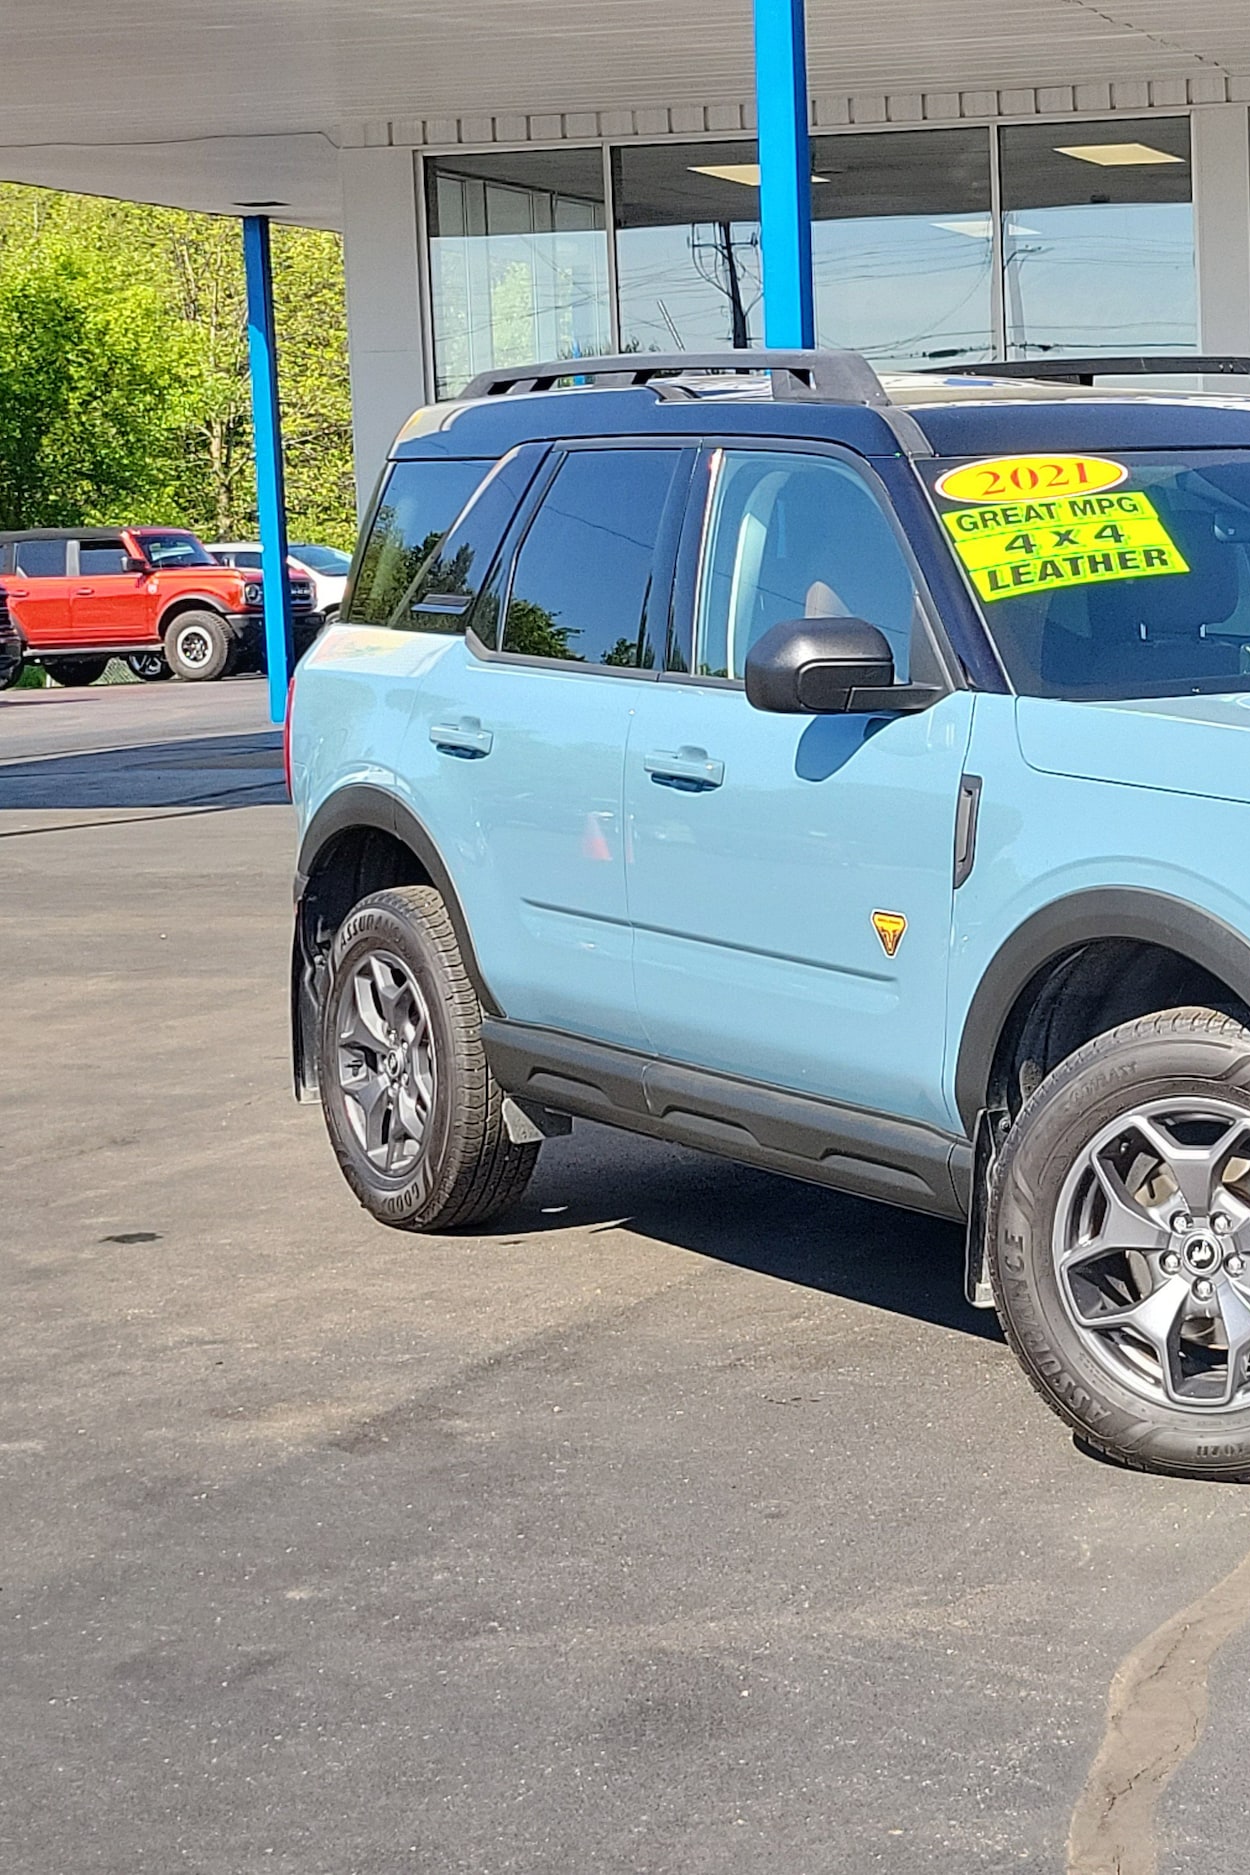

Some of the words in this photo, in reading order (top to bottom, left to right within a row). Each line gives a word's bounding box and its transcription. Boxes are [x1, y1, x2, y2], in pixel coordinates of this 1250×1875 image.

[976, 462, 1090, 496] 2021
[956, 502, 1057, 532] GREAT
[1070, 497, 1139, 518] MPG
[1005, 534, 1036, 555] 4
[1094, 524, 1125, 544] 4
[988, 548, 1170, 593] LEATHER
